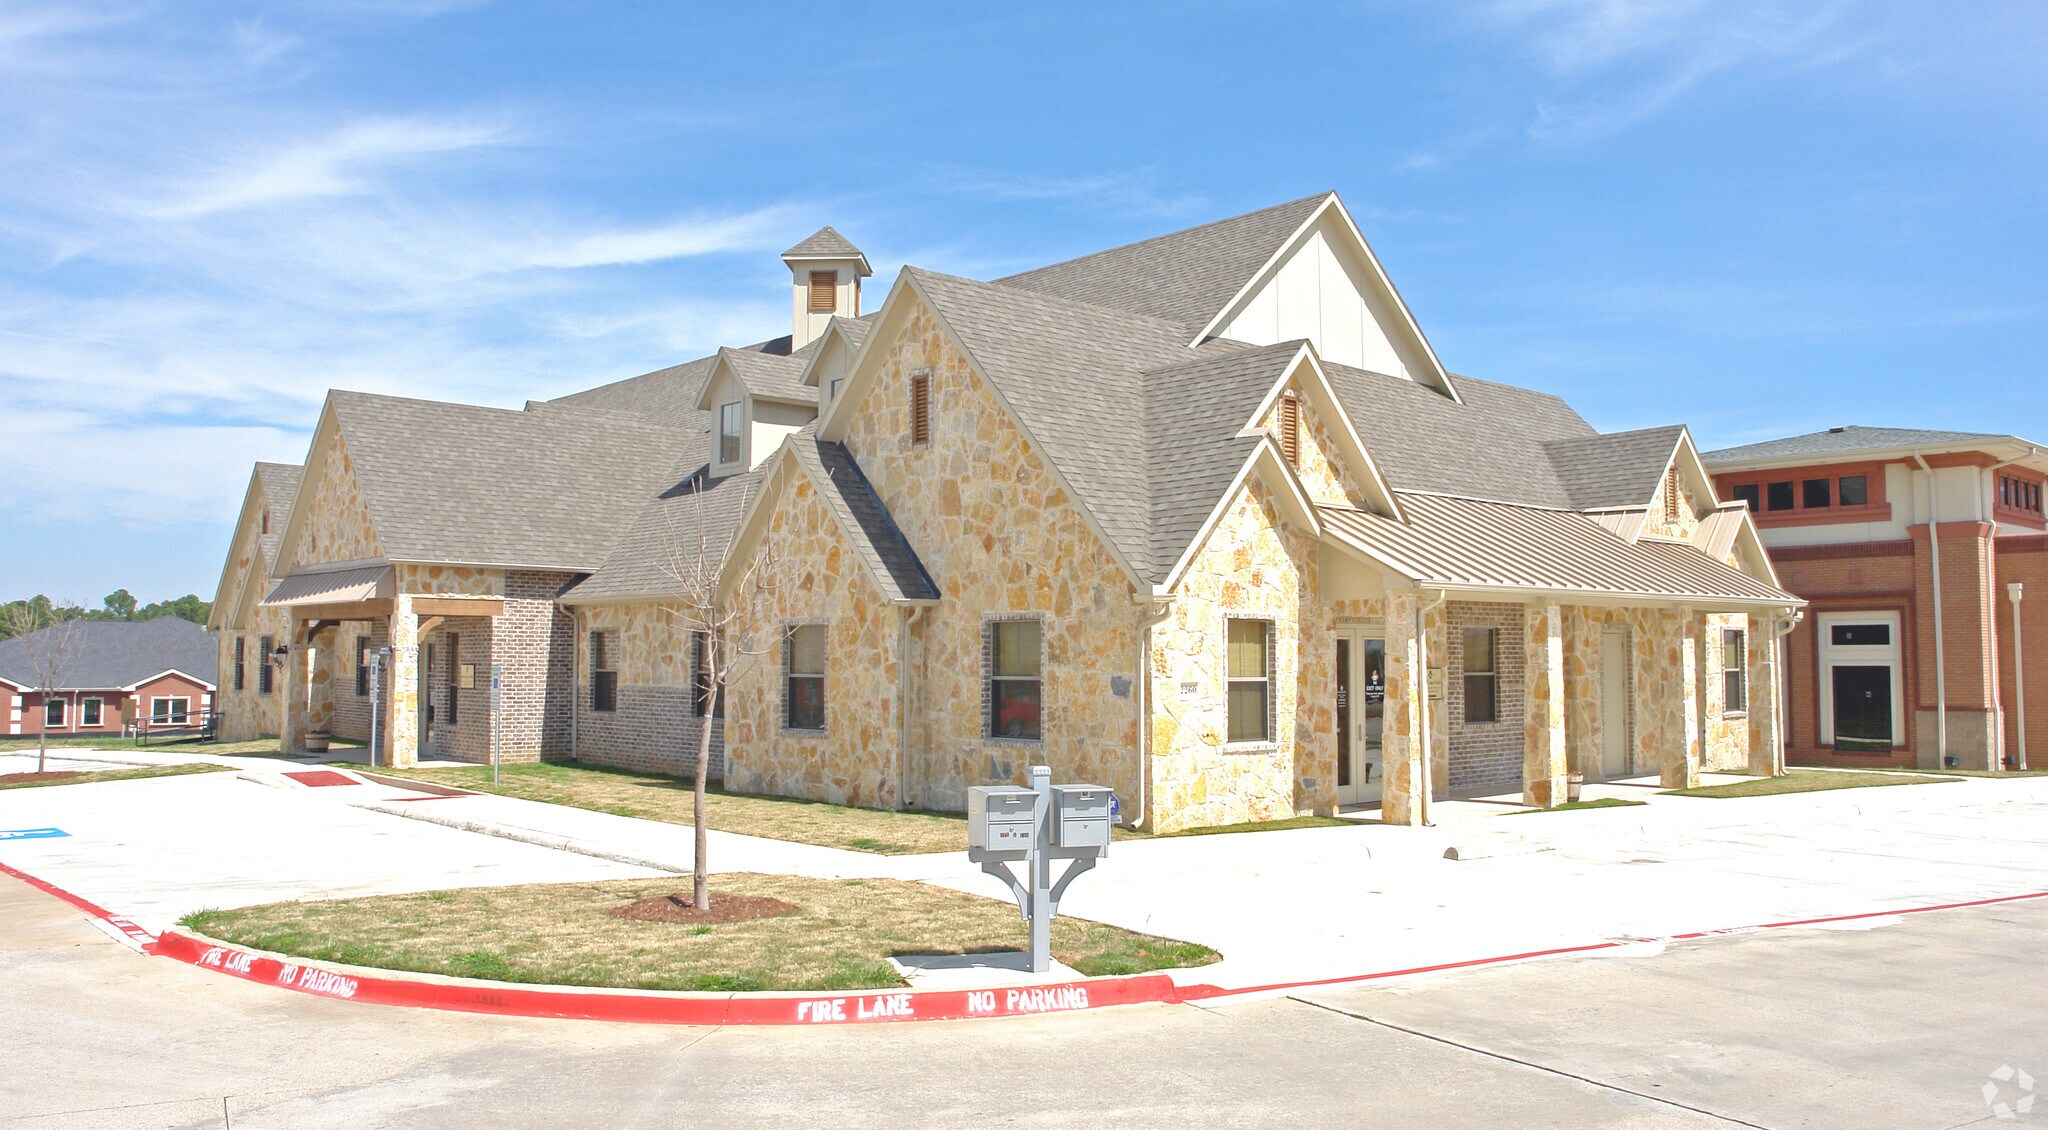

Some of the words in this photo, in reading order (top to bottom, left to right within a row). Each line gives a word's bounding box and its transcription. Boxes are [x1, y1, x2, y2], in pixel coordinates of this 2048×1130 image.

[200, 948, 228, 966] FIRE
[225, 952, 259, 973] LANE
[279, 964, 299, 984] NO
[299, 967, 358, 998] PARKING
[798, 998, 846, 1022] FIRE
[857, 994, 914, 1019] LANE
[968, 991, 996, 1012] NO
[1007, 987, 1089, 1011] PARKING
